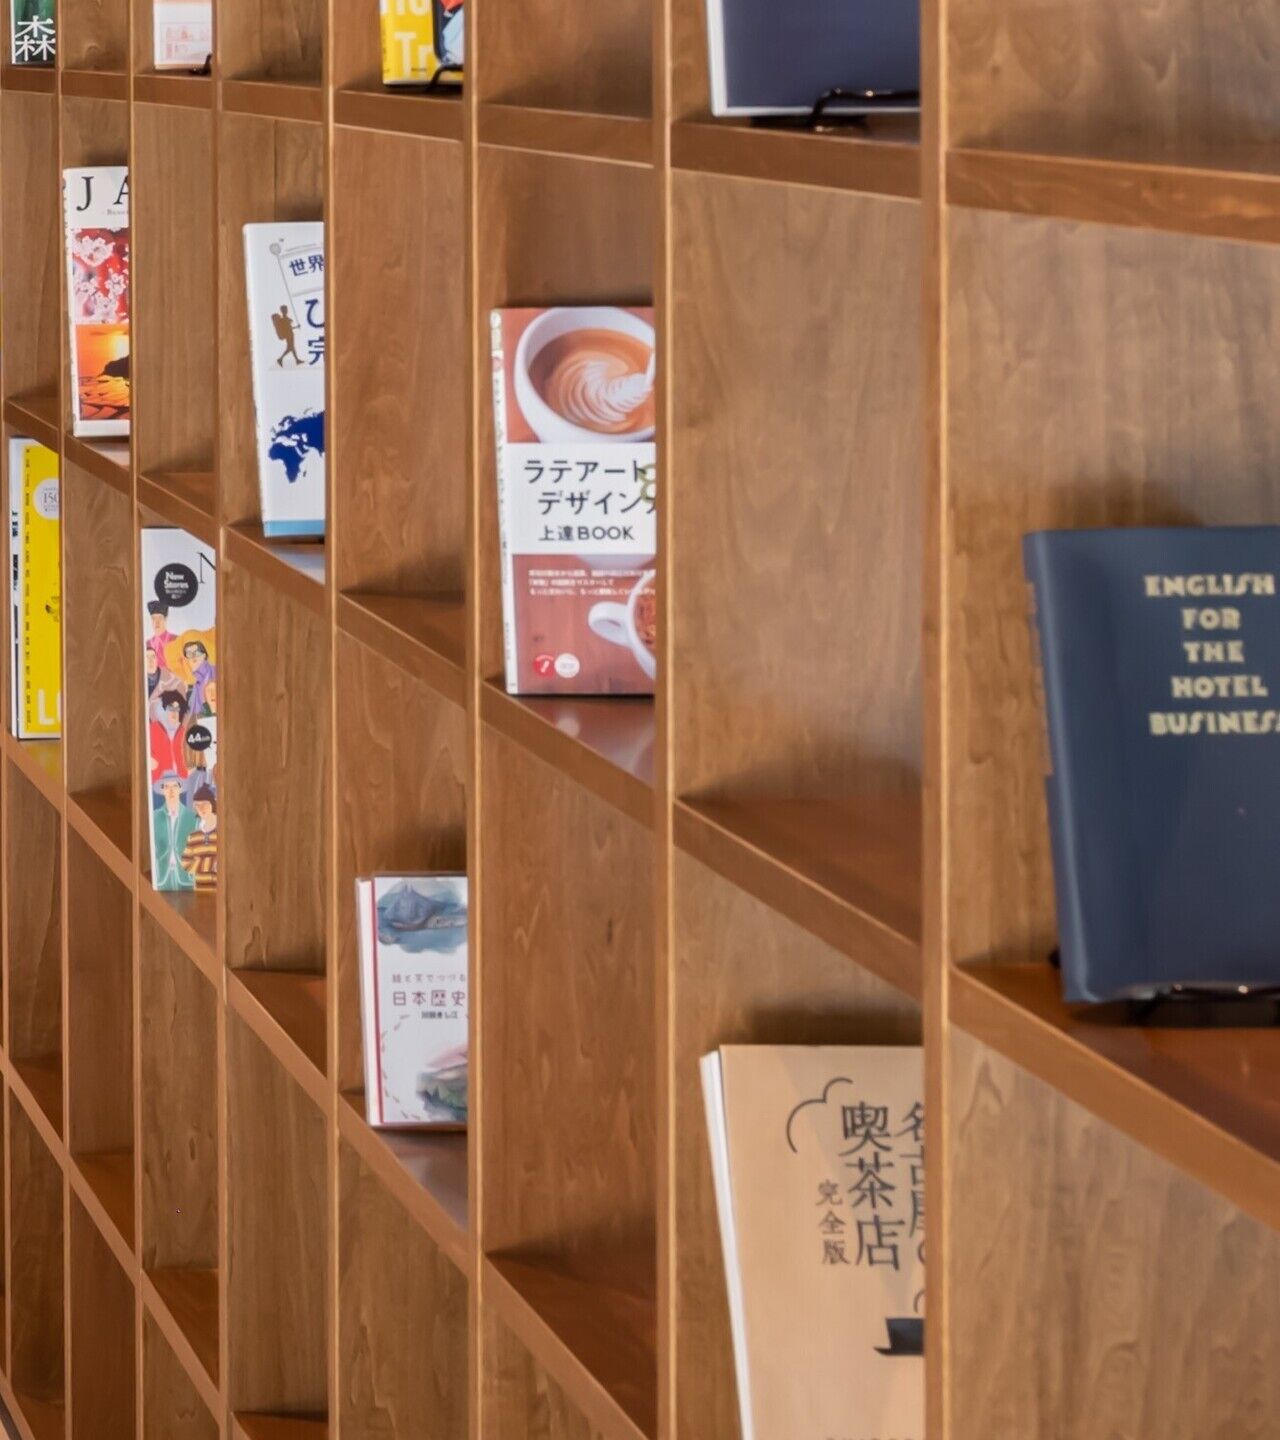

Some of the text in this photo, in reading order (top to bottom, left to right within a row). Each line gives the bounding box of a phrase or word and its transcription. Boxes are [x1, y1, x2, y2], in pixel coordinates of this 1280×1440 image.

[525, 460, 647, 483] ラテアート
[539, 524, 635, 543] 上達BOOK
[1144, 574, 1276, 598] ENGLISH
[1182, 607, 1240, 631] FOR
[1183, 640, 1244, 664] THE
[1171, 676, 1269, 698] HOTEL
[1148, 712, 1280, 735] BUSINES
[393, 990, 465, 1007] 日本歴史
[839, 1100, 906, 1272] 喫茶店
[815, 1179, 851, 1266] 完全版
